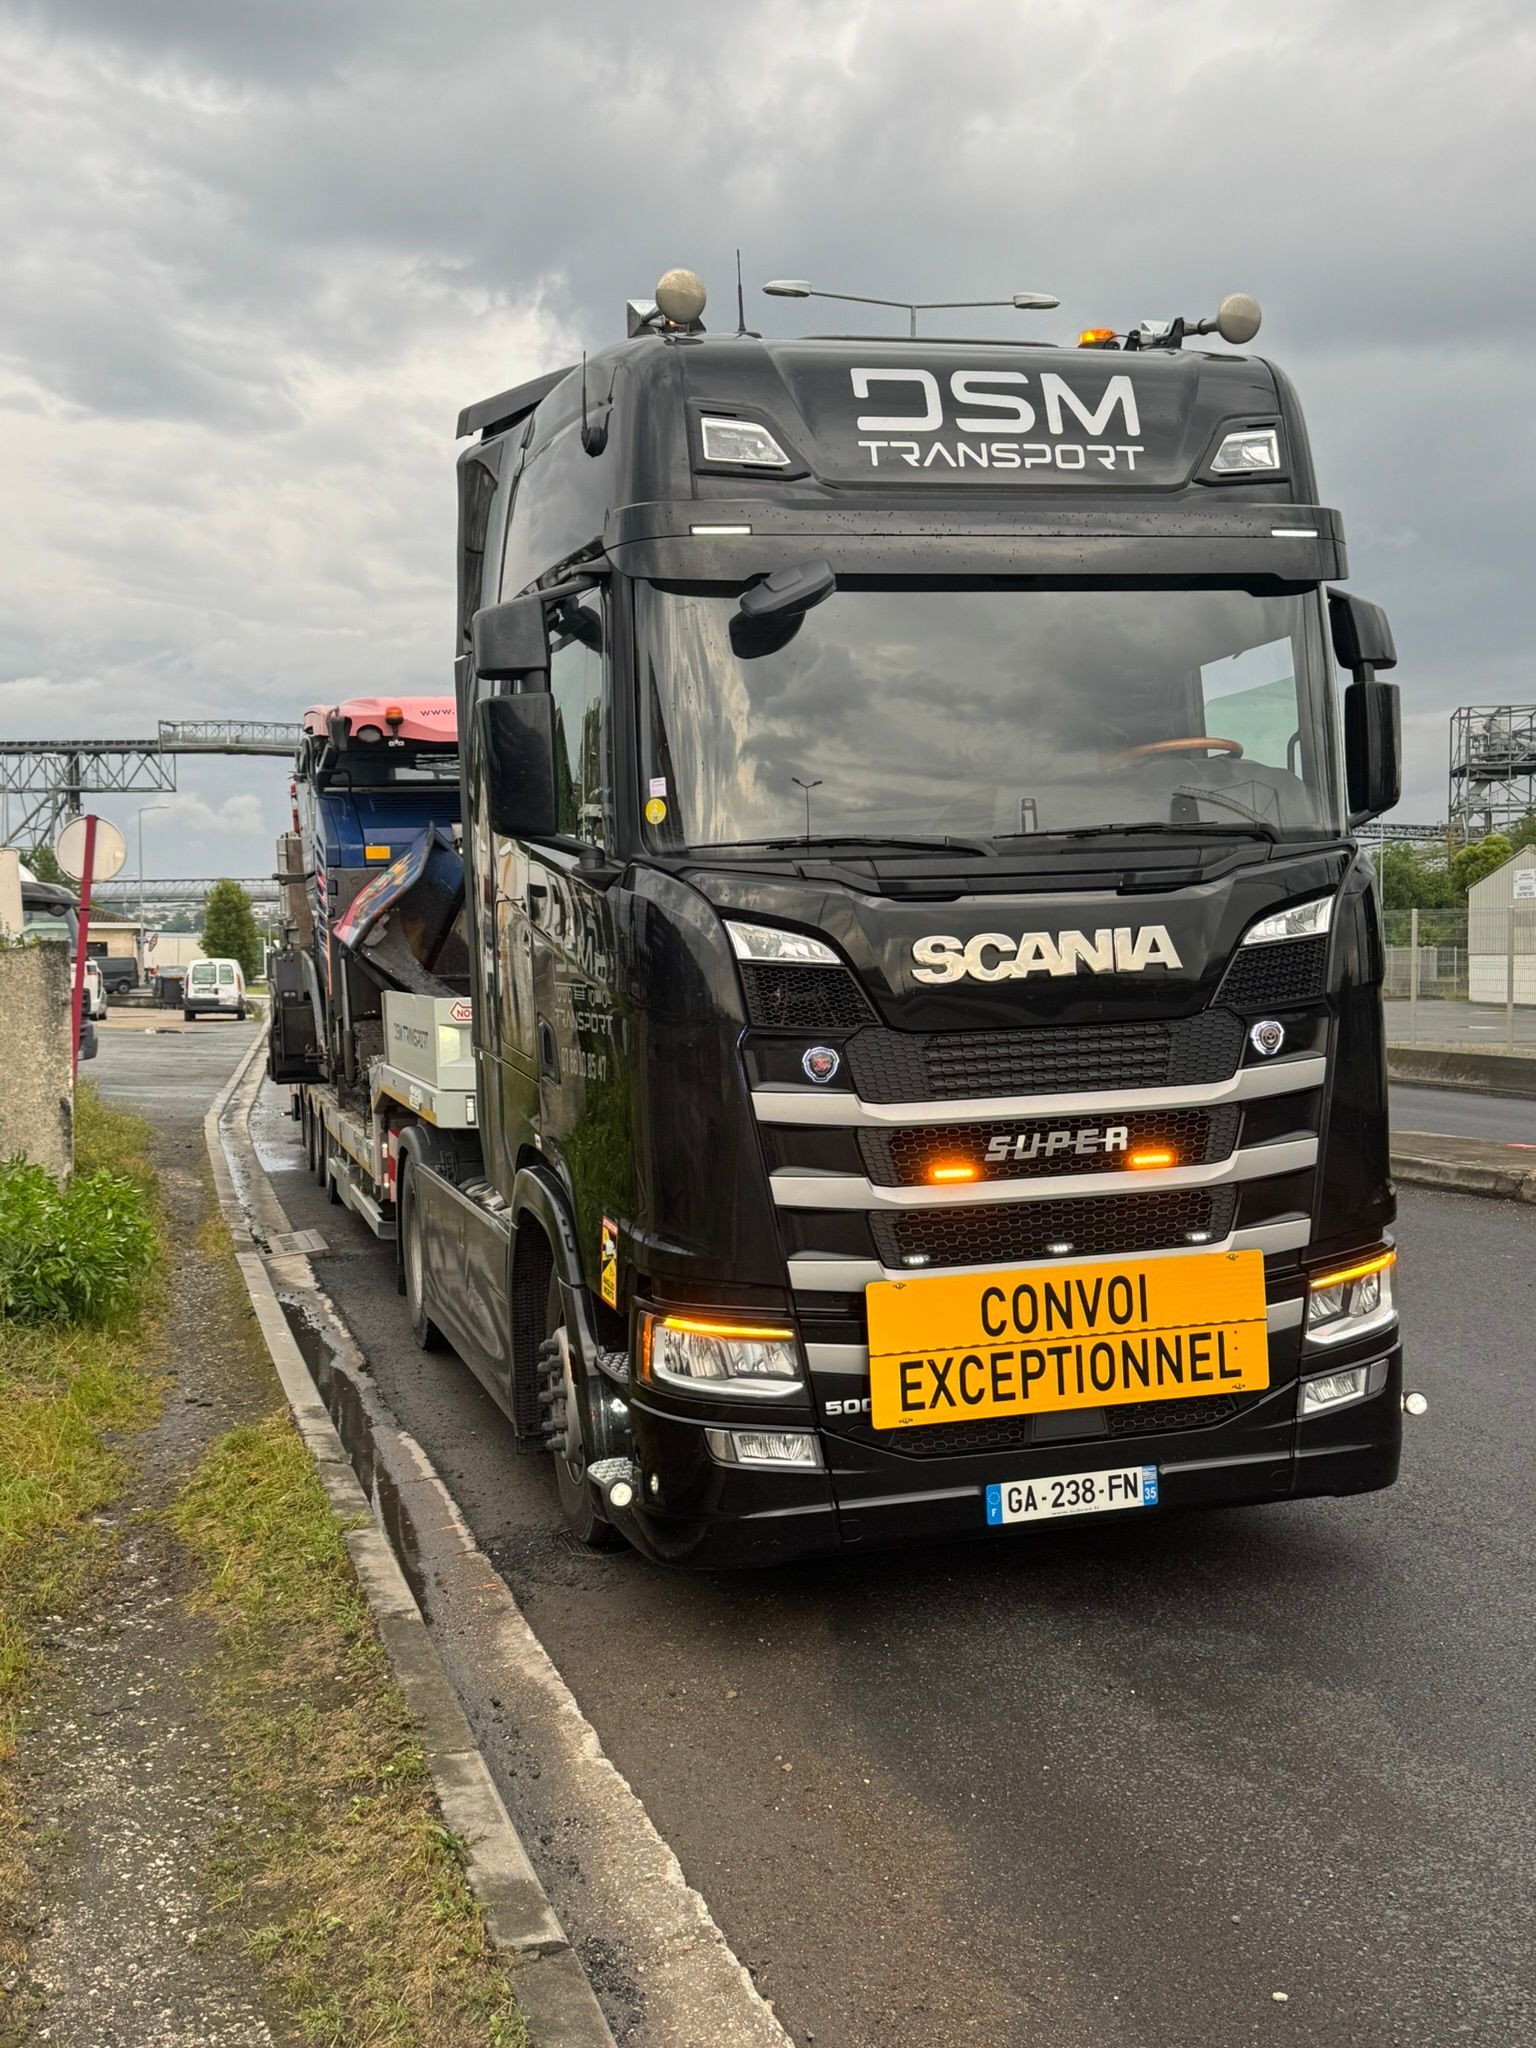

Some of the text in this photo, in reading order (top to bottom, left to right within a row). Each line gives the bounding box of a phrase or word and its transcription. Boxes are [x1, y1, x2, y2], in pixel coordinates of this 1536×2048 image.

[850, 368, 1140, 436] DSM
[858, 440, 1144, 470] TRANSPORT
[910, 925, 1183, 983] SCANIA
[554, 1008, 613, 1036] TRANSPORT
[985, 1126, 1128, 1161] SUPER
[981, 1274, 1147, 1337] CONVOI
[900, 1331, 1242, 1411] EXCEPTIONNEL
[991, 1508, 997, 1517] F
[1008, 1472, 1138, 1513] GA-238-FN
[1145, 1487, 1157, 1500] 35
